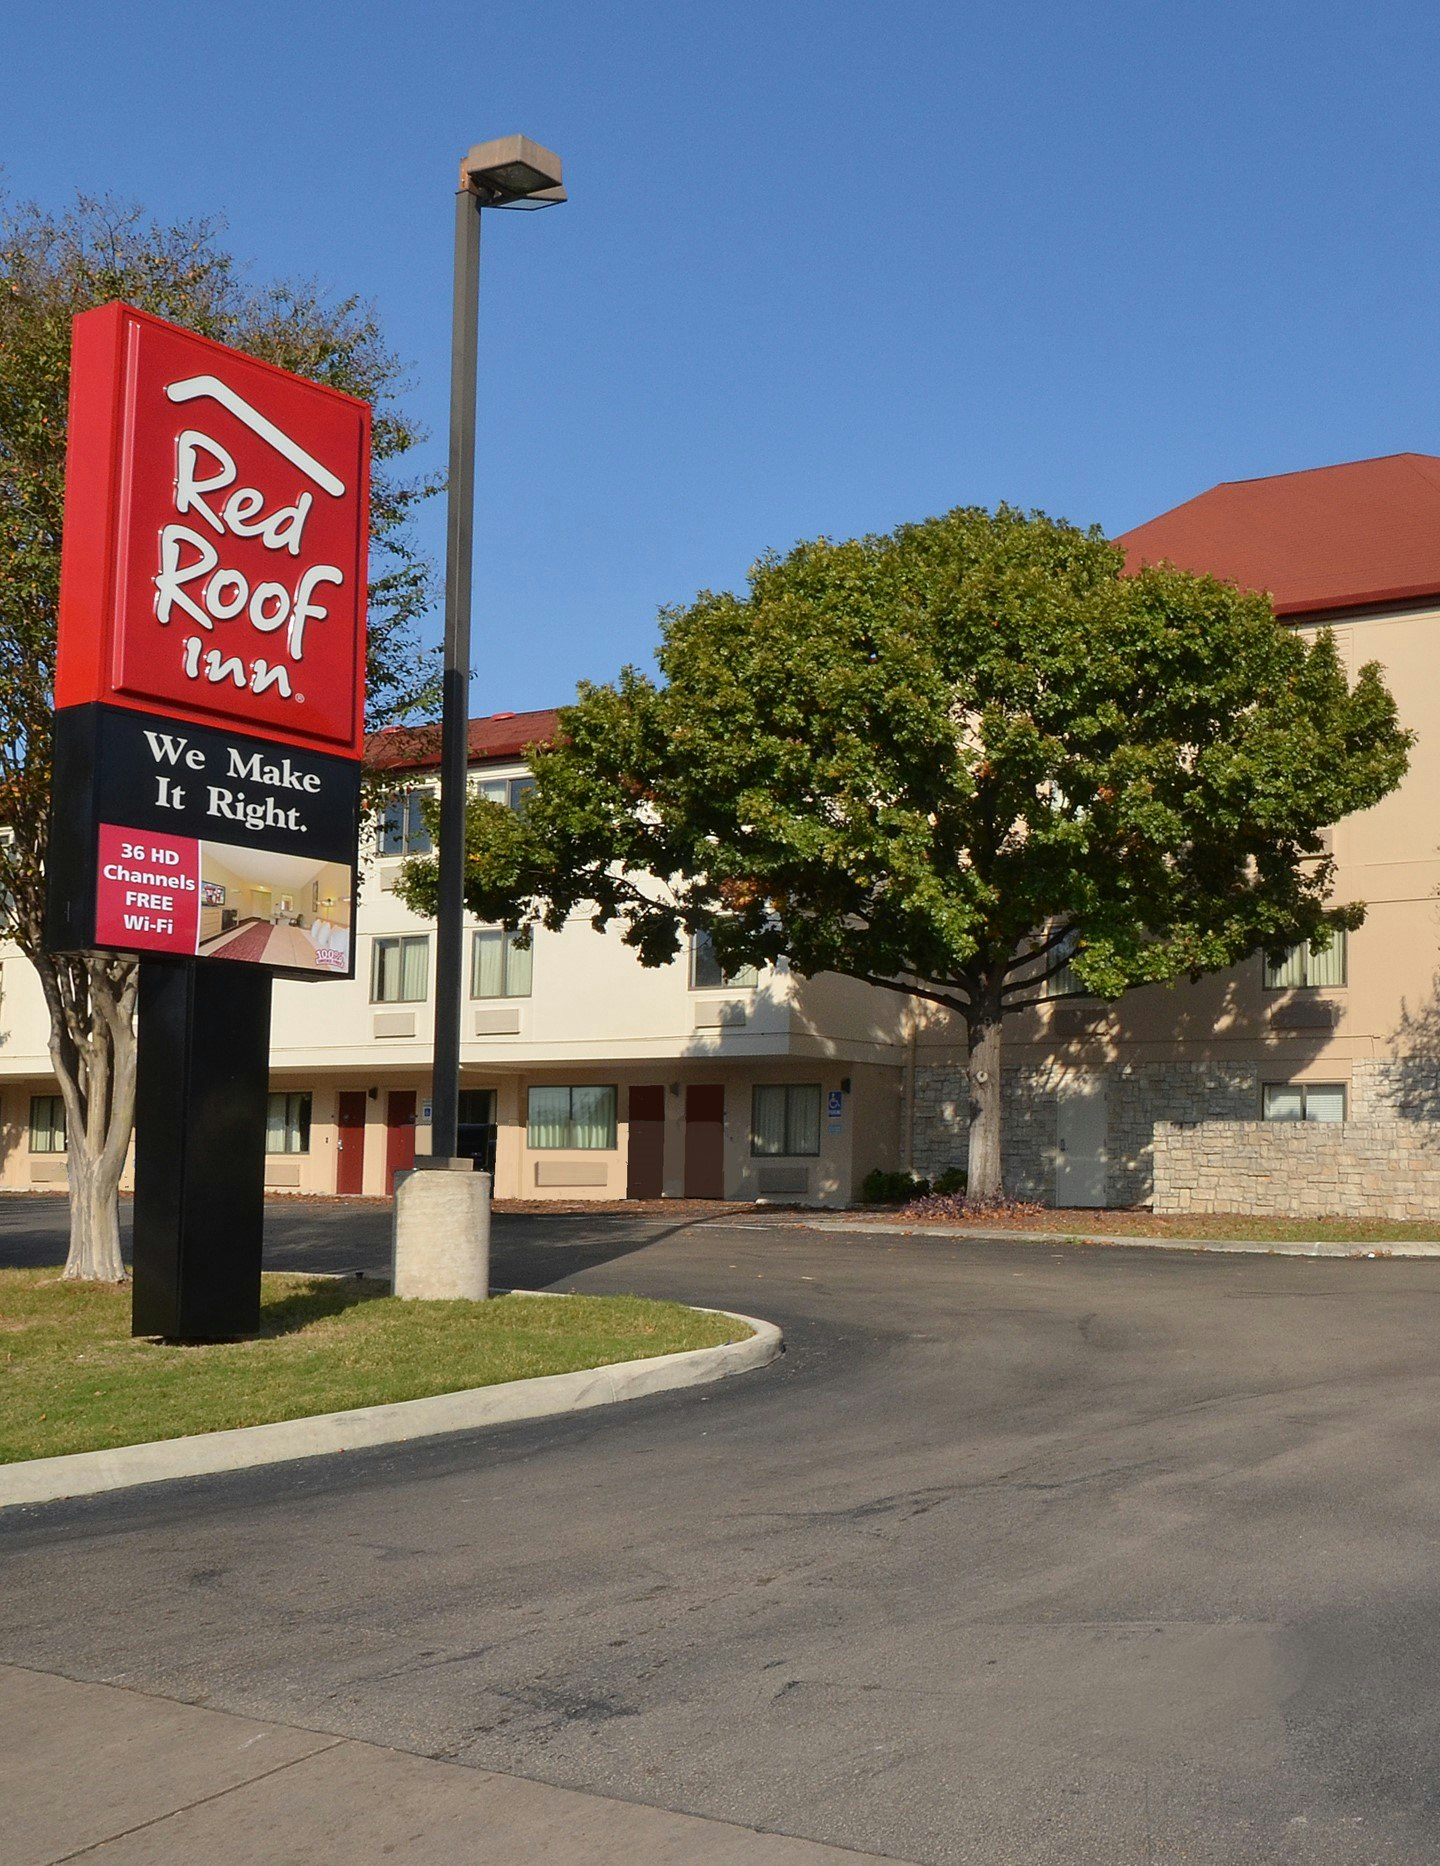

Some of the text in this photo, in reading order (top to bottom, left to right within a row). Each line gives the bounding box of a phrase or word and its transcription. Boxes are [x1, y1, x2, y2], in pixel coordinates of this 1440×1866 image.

[176, 429, 313, 556] Red
[155, 523, 344, 661] Roof
[185, 636, 292, 698] Inn
[143, 730, 322, 794] We Make
[155, 775, 308, 833] It Right.
[103, 864, 196, 891] Channels
[120, 843, 180, 866] 36 HD
[123, 914, 174, 935] Wi-Fi
[125, 891, 174, 912] FREE
